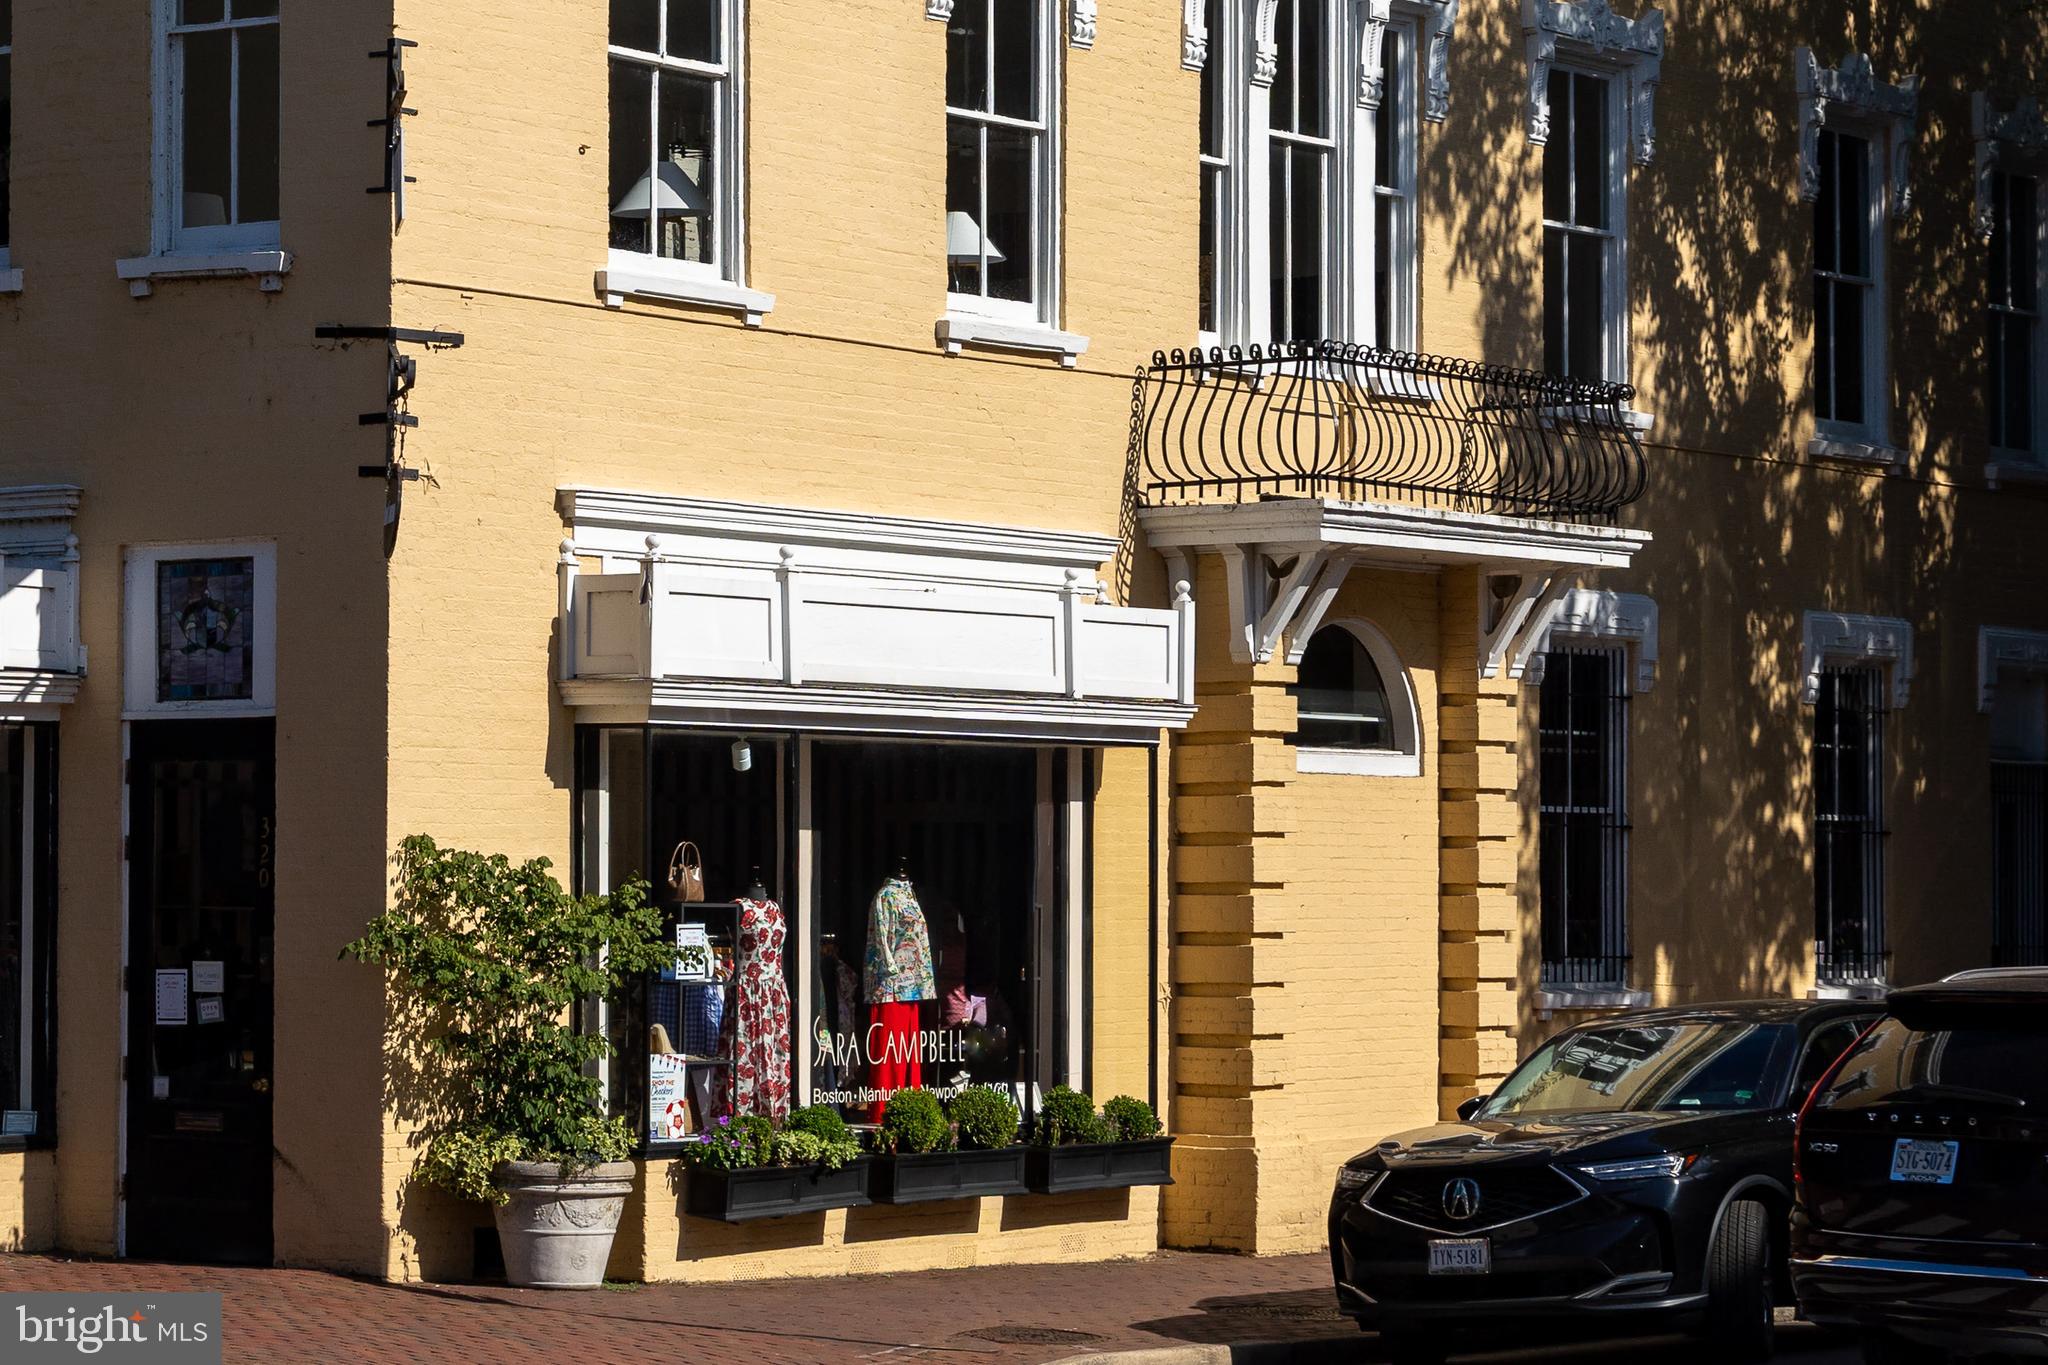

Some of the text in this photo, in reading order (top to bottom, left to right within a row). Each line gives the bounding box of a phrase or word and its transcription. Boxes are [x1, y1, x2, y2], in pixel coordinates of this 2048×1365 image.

[258, 816, 271, 889] 320
[866, 1022, 966, 1065] CAMPBELL
[813, 1087, 851, 1105] Boston
[858, 1085, 914, 1102] Nantuc
[1897, 1150, 1953, 1171] SYG-5074
[1433, 1248, 1482, 1266] TYN-5181
